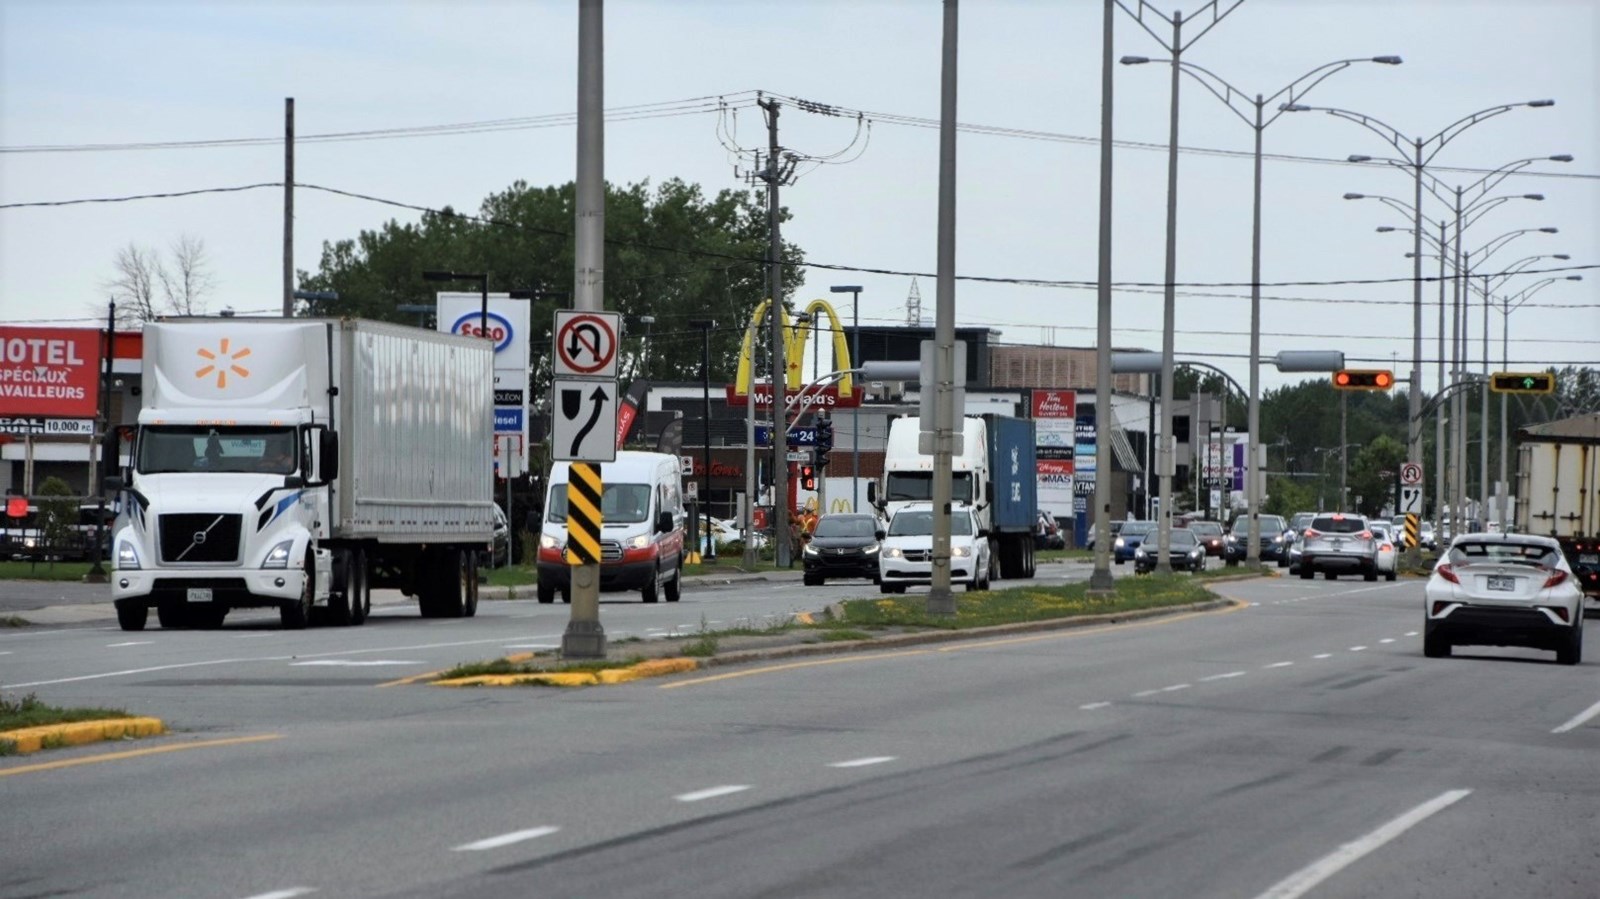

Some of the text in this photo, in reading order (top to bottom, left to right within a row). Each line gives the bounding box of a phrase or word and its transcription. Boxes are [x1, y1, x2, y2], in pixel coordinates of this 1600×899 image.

[0, 338, 84, 365] OTEL
[754, 393, 835, 405] Mconald's
[1047, 393, 1061, 402] Tim
[1039, 401, 1068, 411] Hortons
[494, 416, 517, 425] iesel
[47, 421, 79, 431] 10,000
[799, 431, 814, 442] 24
